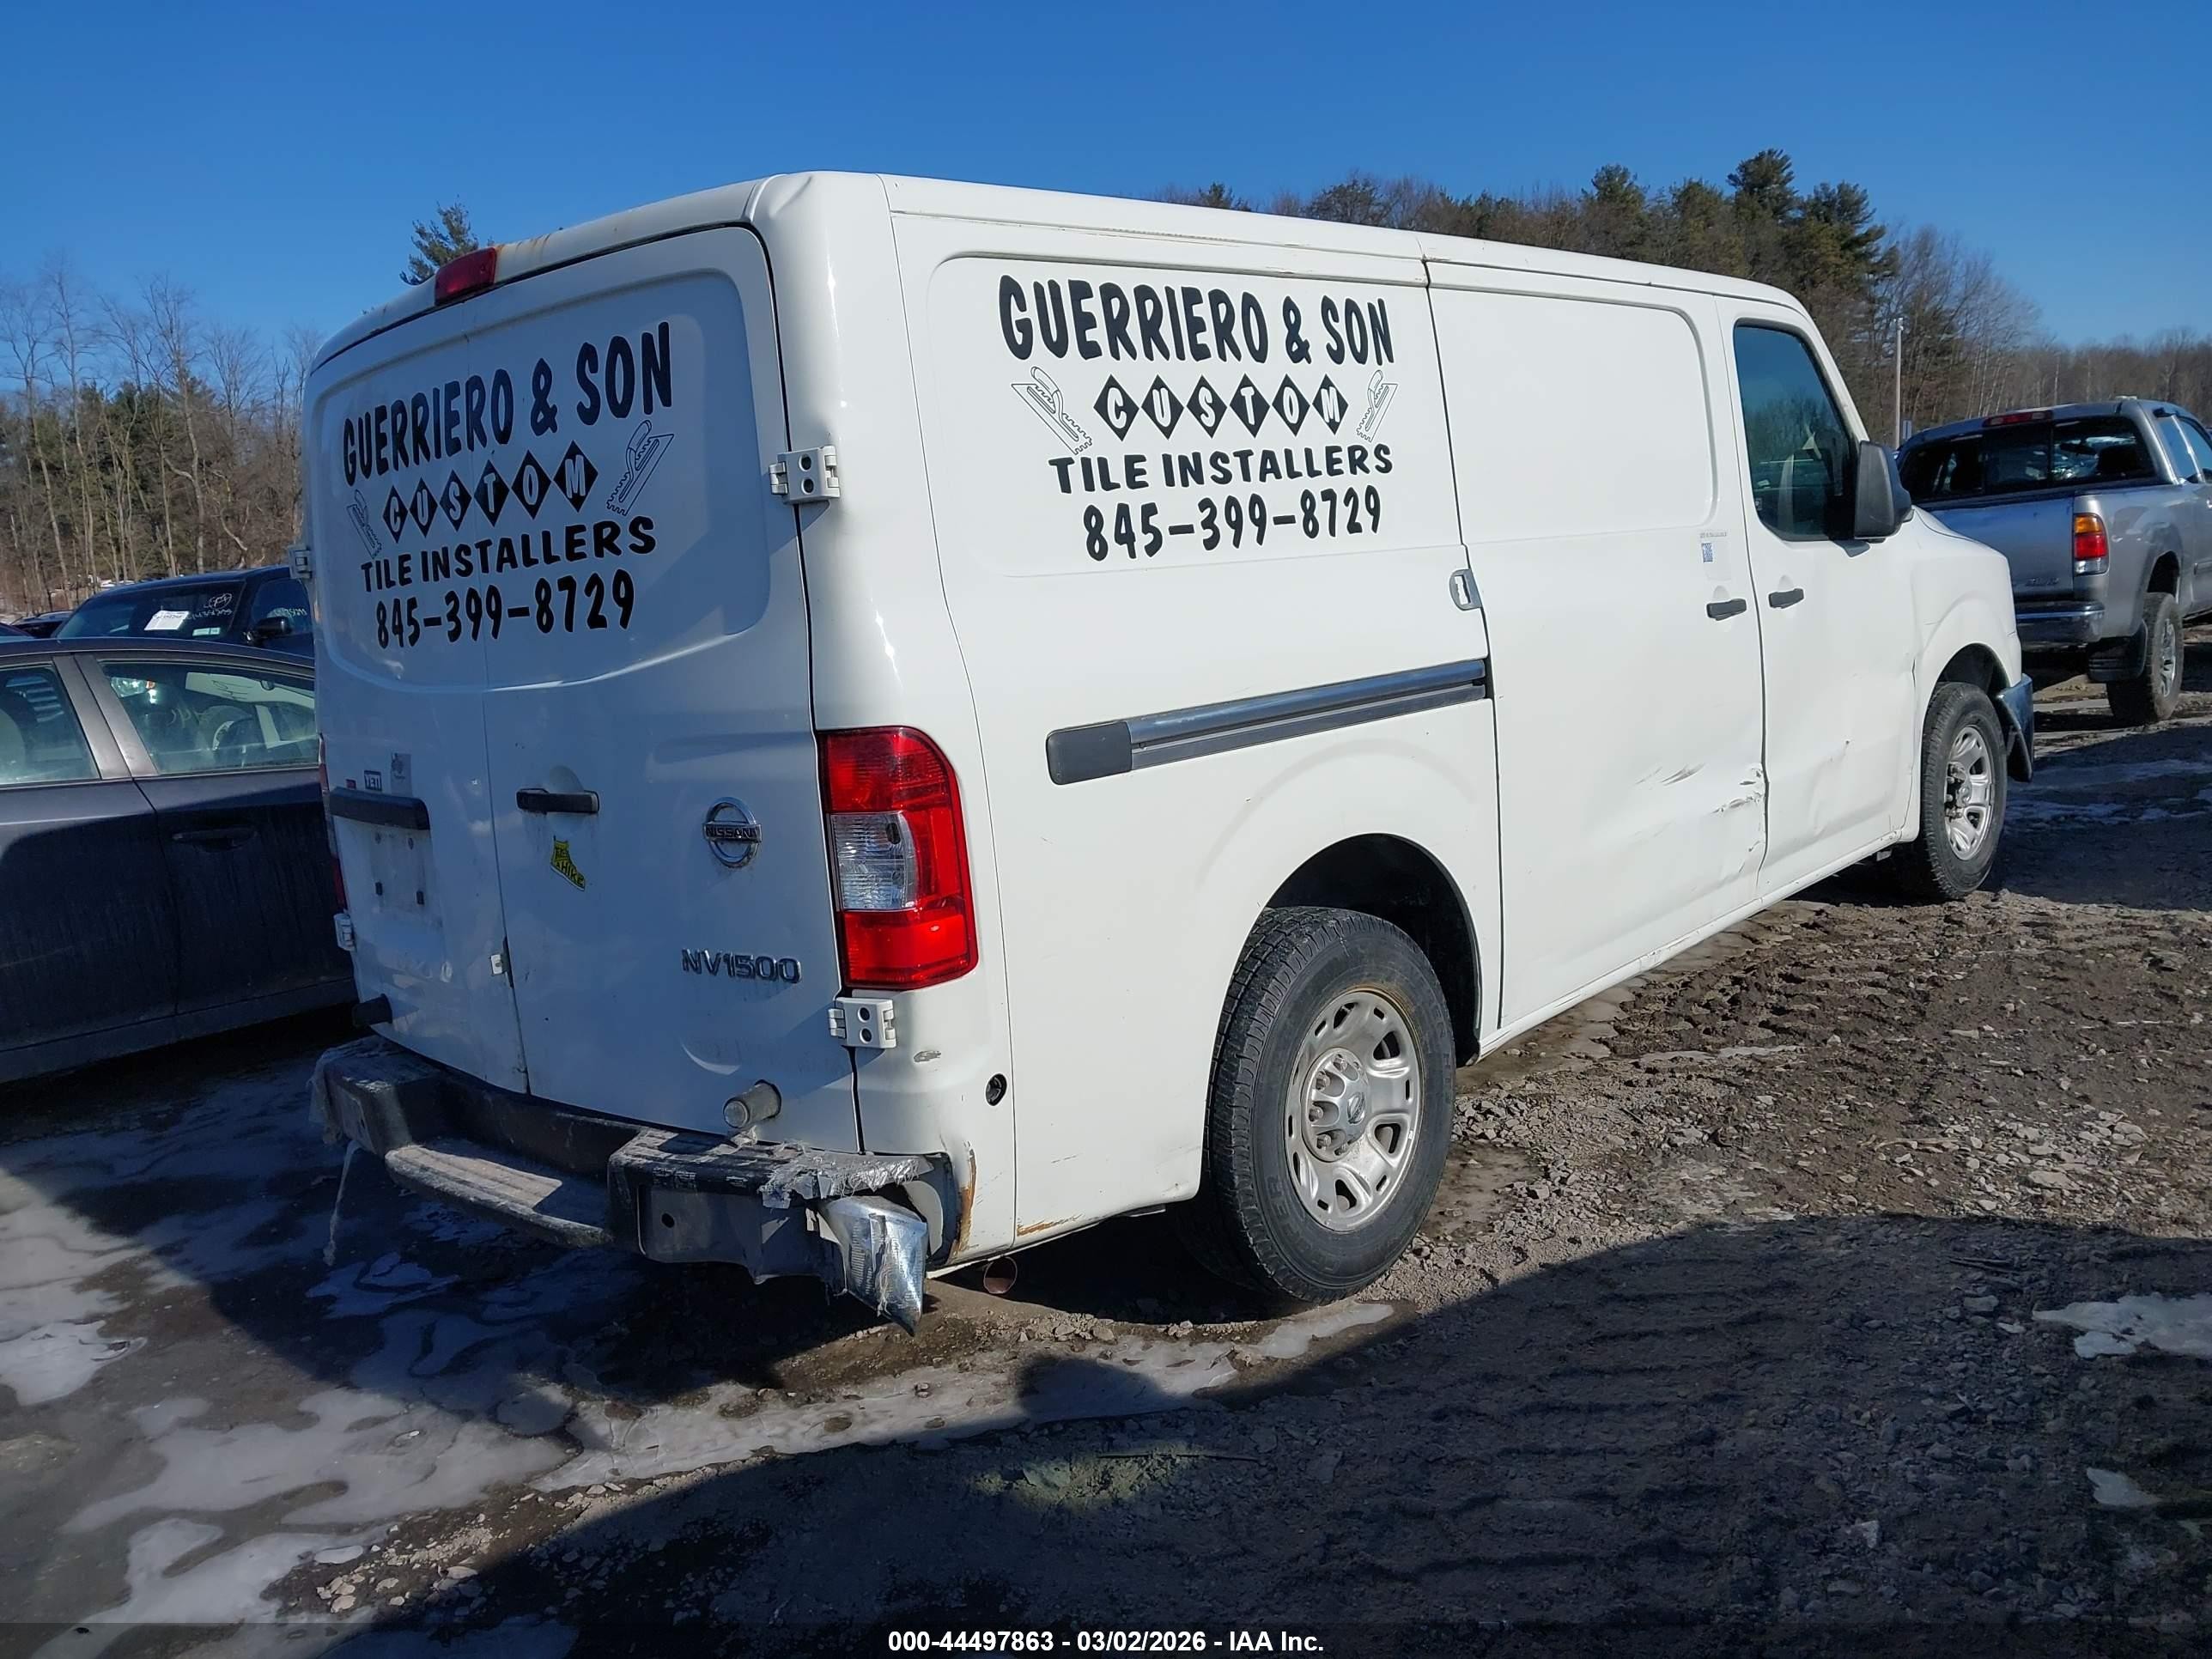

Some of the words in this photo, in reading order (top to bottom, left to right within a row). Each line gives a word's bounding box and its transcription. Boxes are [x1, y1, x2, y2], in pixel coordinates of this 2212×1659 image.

[1000, 275, 1268, 363] GUERRIERO
[1283, 296, 1311, 364] &
[1321, 295, 1395, 365] SON
[344, 368, 514, 486] GUERRIERO
[530, 358, 558, 436] &
[576, 322, 672, 426] SON
[1106, 386, 1340, 429] CUSTOM
[389, 457, 586, 532] CUSTOM
[1048, 454, 1149, 494] TILE
[1162, 444, 1393, 488] INSTALLERS
[362, 554, 412, 592] TILE
[422, 516, 656, 583] INSTALLERS
[1084, 485, 1381, 562] 845-399-8729
[376, 568, 635, 649] 845-399-8729
[706, 825, 757, 839] NISSAN
[682, 948, 802, 984] NV1500
